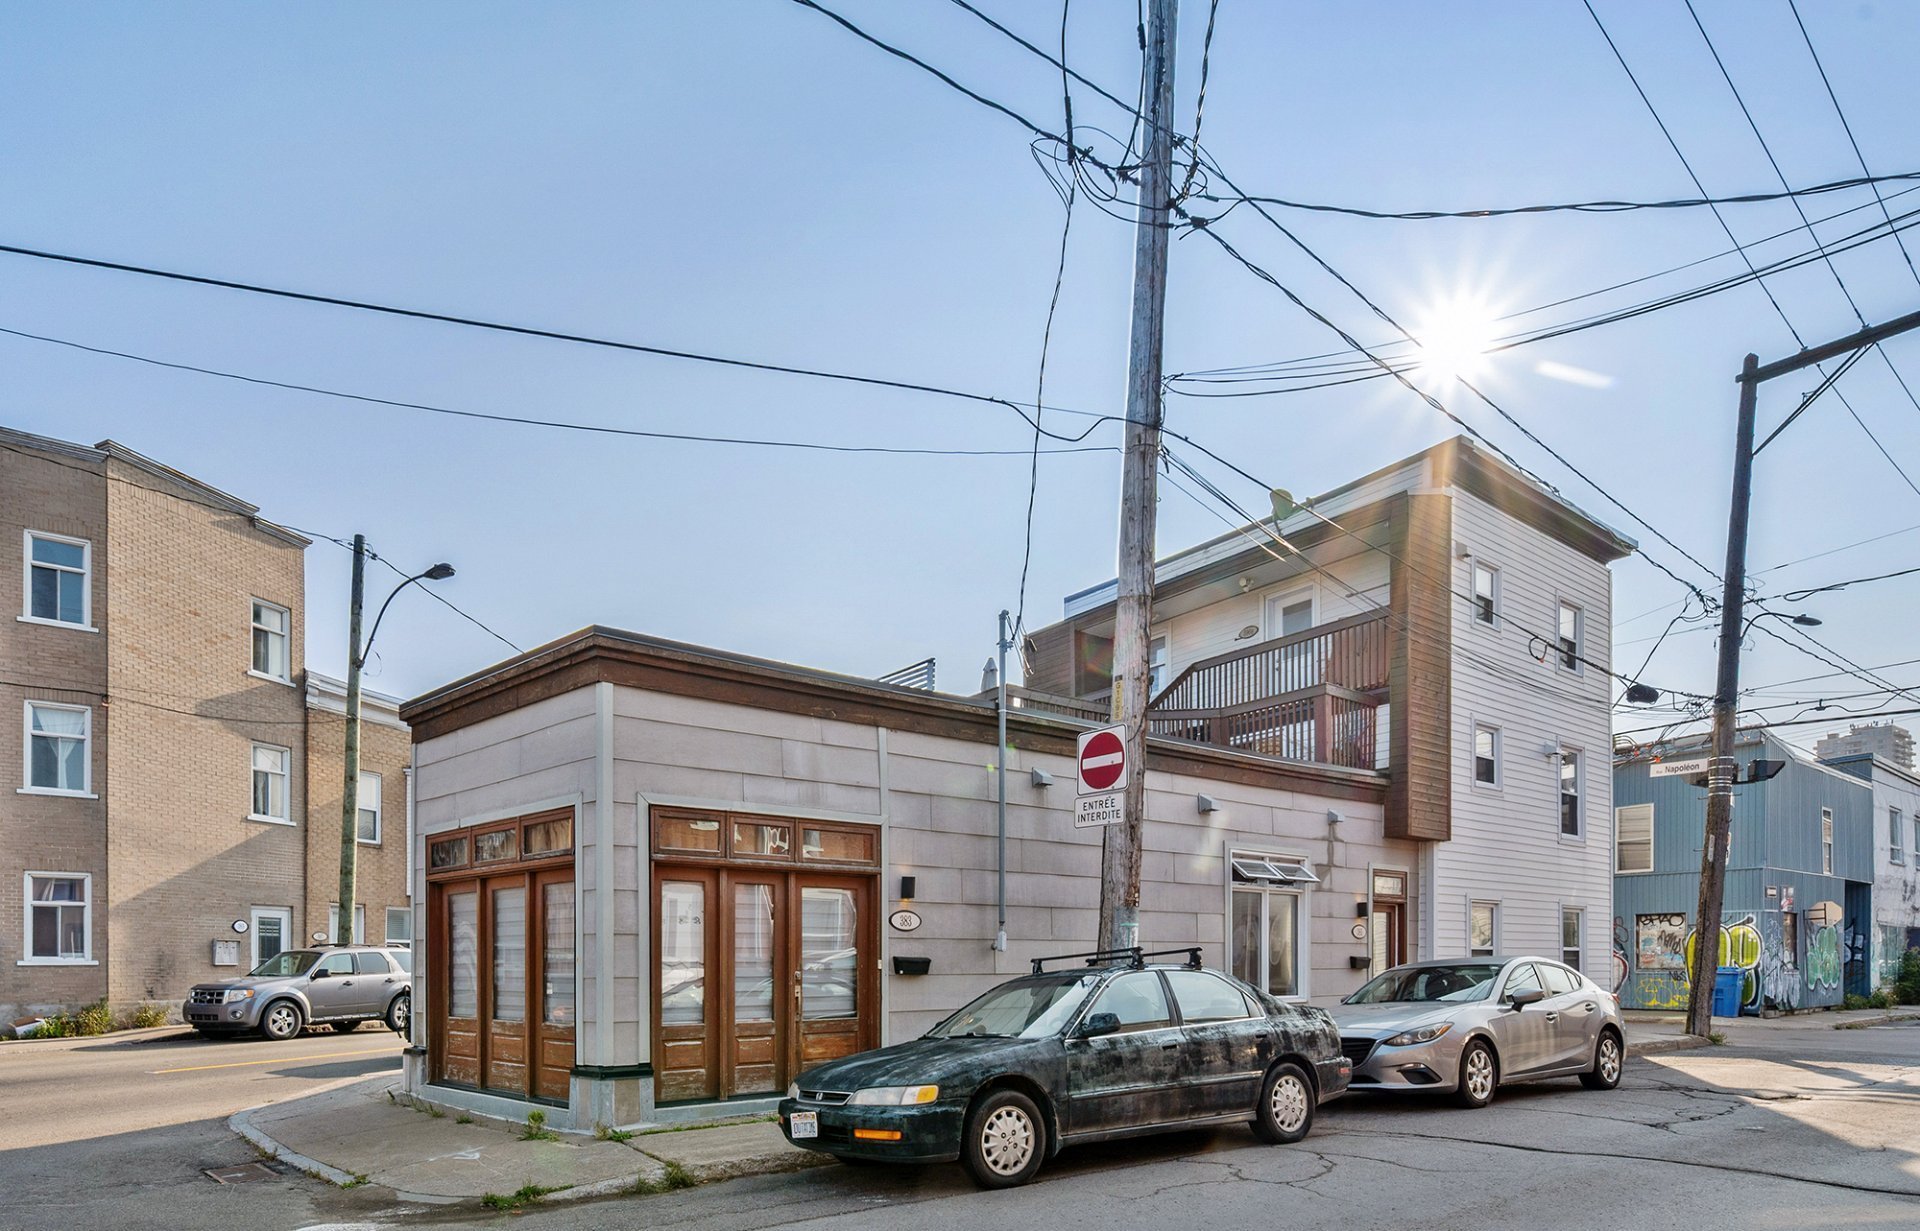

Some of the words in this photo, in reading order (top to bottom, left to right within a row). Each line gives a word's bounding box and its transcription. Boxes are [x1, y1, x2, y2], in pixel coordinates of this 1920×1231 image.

[1665, 763, 1700, 774] Napoléon
[1083, 797, 1116, 812] ENTRÉE
[1077, 809, 1121, 823] INTERDITE
[899, 914, 912, 927] 383
